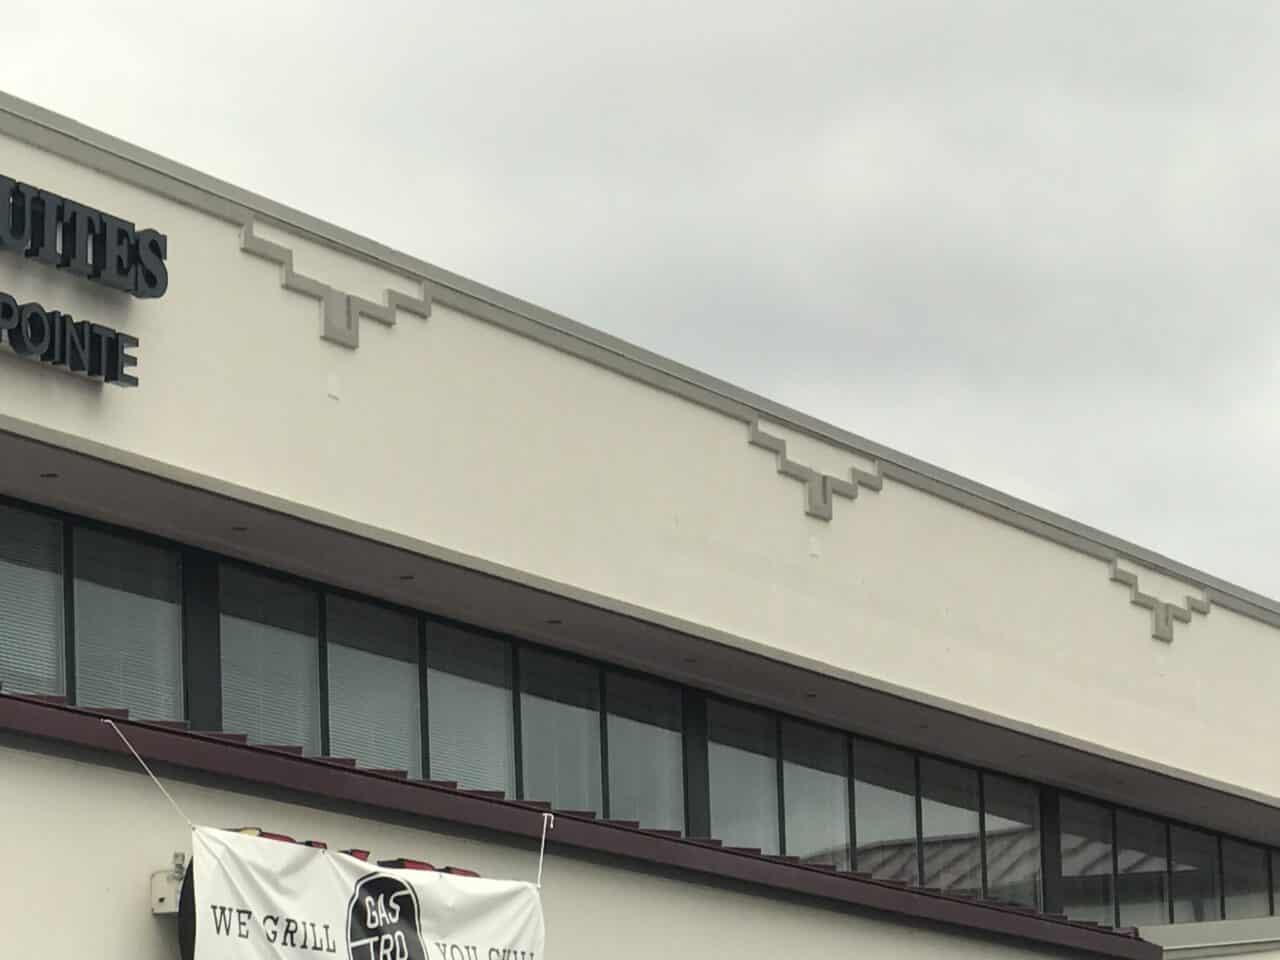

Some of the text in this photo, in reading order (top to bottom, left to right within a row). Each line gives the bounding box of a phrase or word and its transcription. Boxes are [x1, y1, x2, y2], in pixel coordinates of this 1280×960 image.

[210, 904, 337, 953] WE GRILL
[364, 888, 406, 931] GAS
